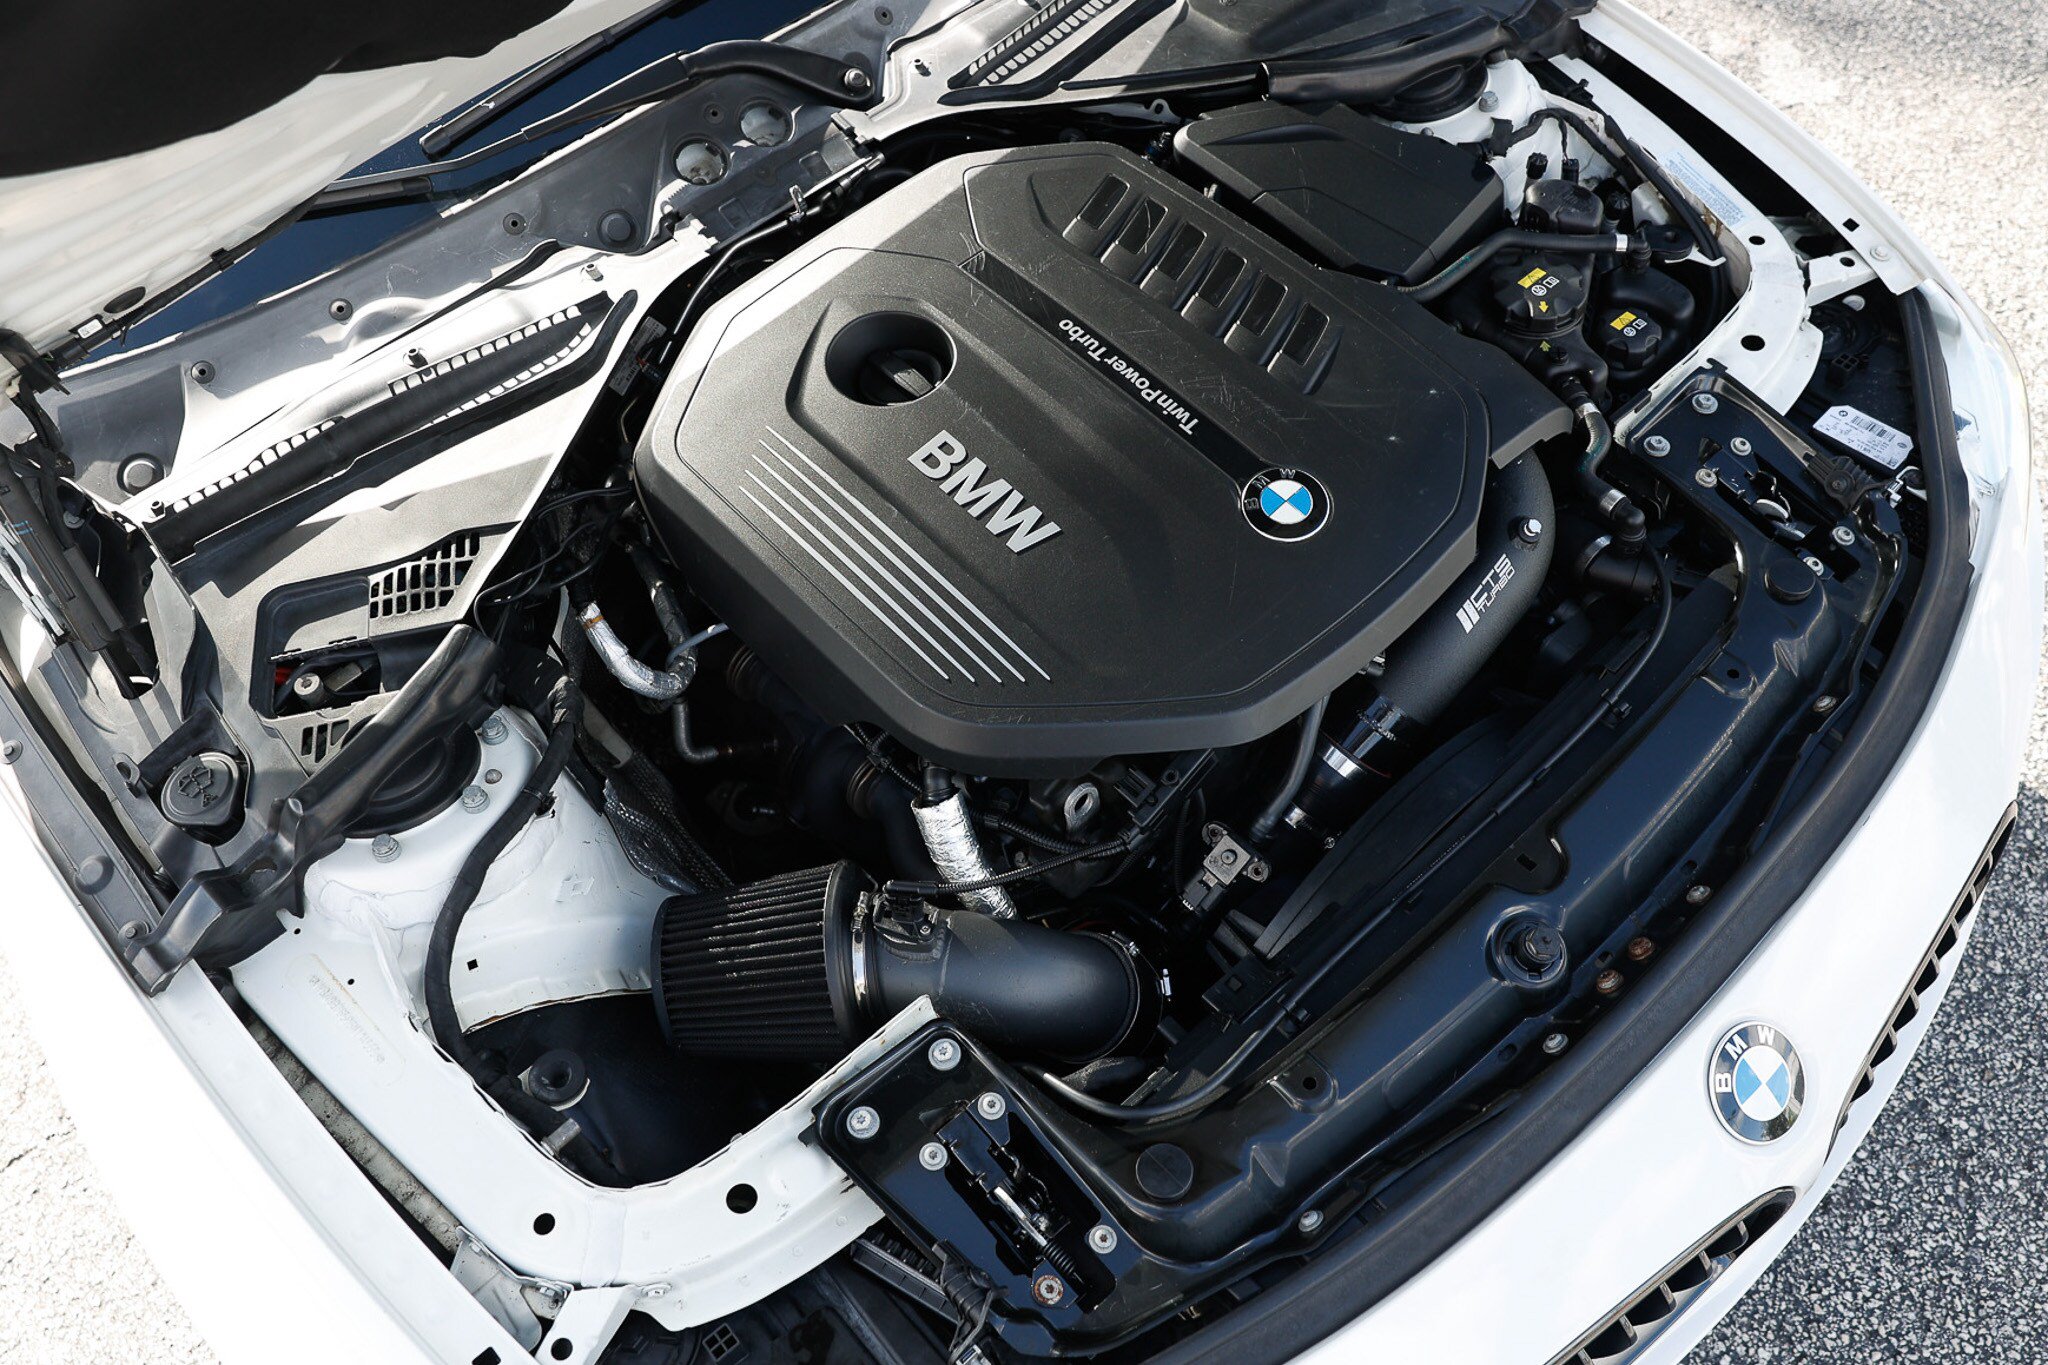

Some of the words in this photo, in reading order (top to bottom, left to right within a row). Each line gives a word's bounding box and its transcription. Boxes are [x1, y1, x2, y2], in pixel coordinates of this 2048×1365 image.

[907, 429, 1063, 554] BMW
[1244, 468, 1296, 510] BMW
[1470, 553, 1511, 608] CTS
[1478, 566, 1515, 613] TURBO
[1715, 1025, 1776, 1093] BMW
